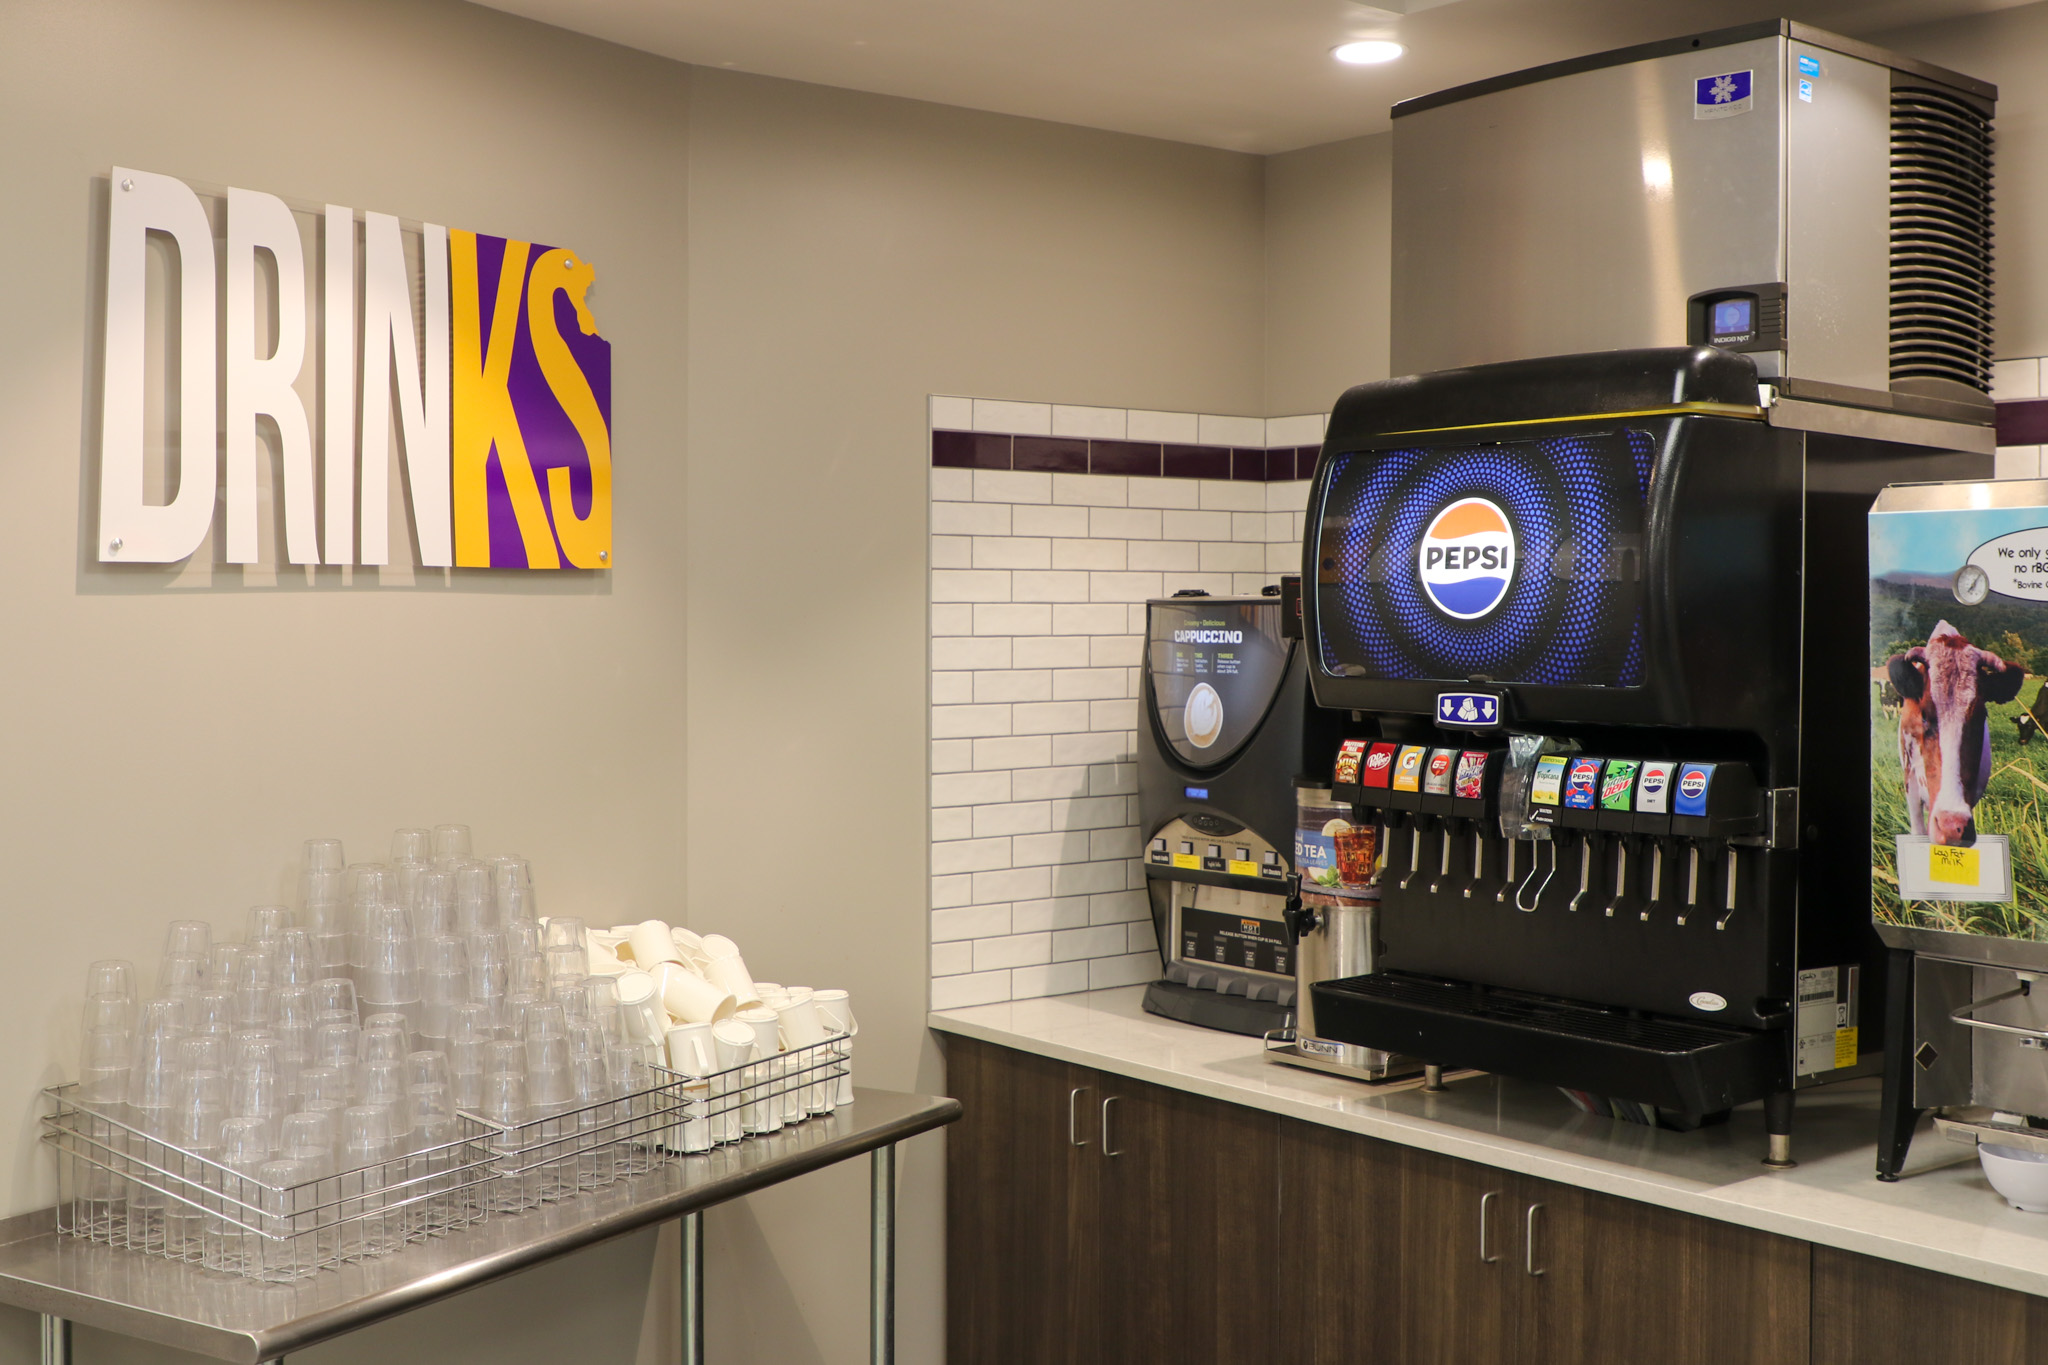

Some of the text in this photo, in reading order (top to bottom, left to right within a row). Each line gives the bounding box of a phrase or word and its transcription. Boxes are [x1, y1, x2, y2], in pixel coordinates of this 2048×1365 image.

[99, 166, 612, 569] DRINKS
[1426, 545, 1508, 570] PEPSI
[1998, 548, 2014, 558] We
[2018, 547, 2041, 560] only
[2014, 565, 2028, 573] no
[1174, 630, 1243, 644] CAPPUCCINO
[1338, 758, 1357, 771] MUG
[1403, 752, 1417, 769] G
[1432, 760, 1447, 769] G2
[1537, 770, 1559, 780] Tropicana
[1304, 844, 1327, 858] TEA
[1934, 848, 1965, 858] Low Fat
[1309, 1043, 1338, 1054] BUNN
